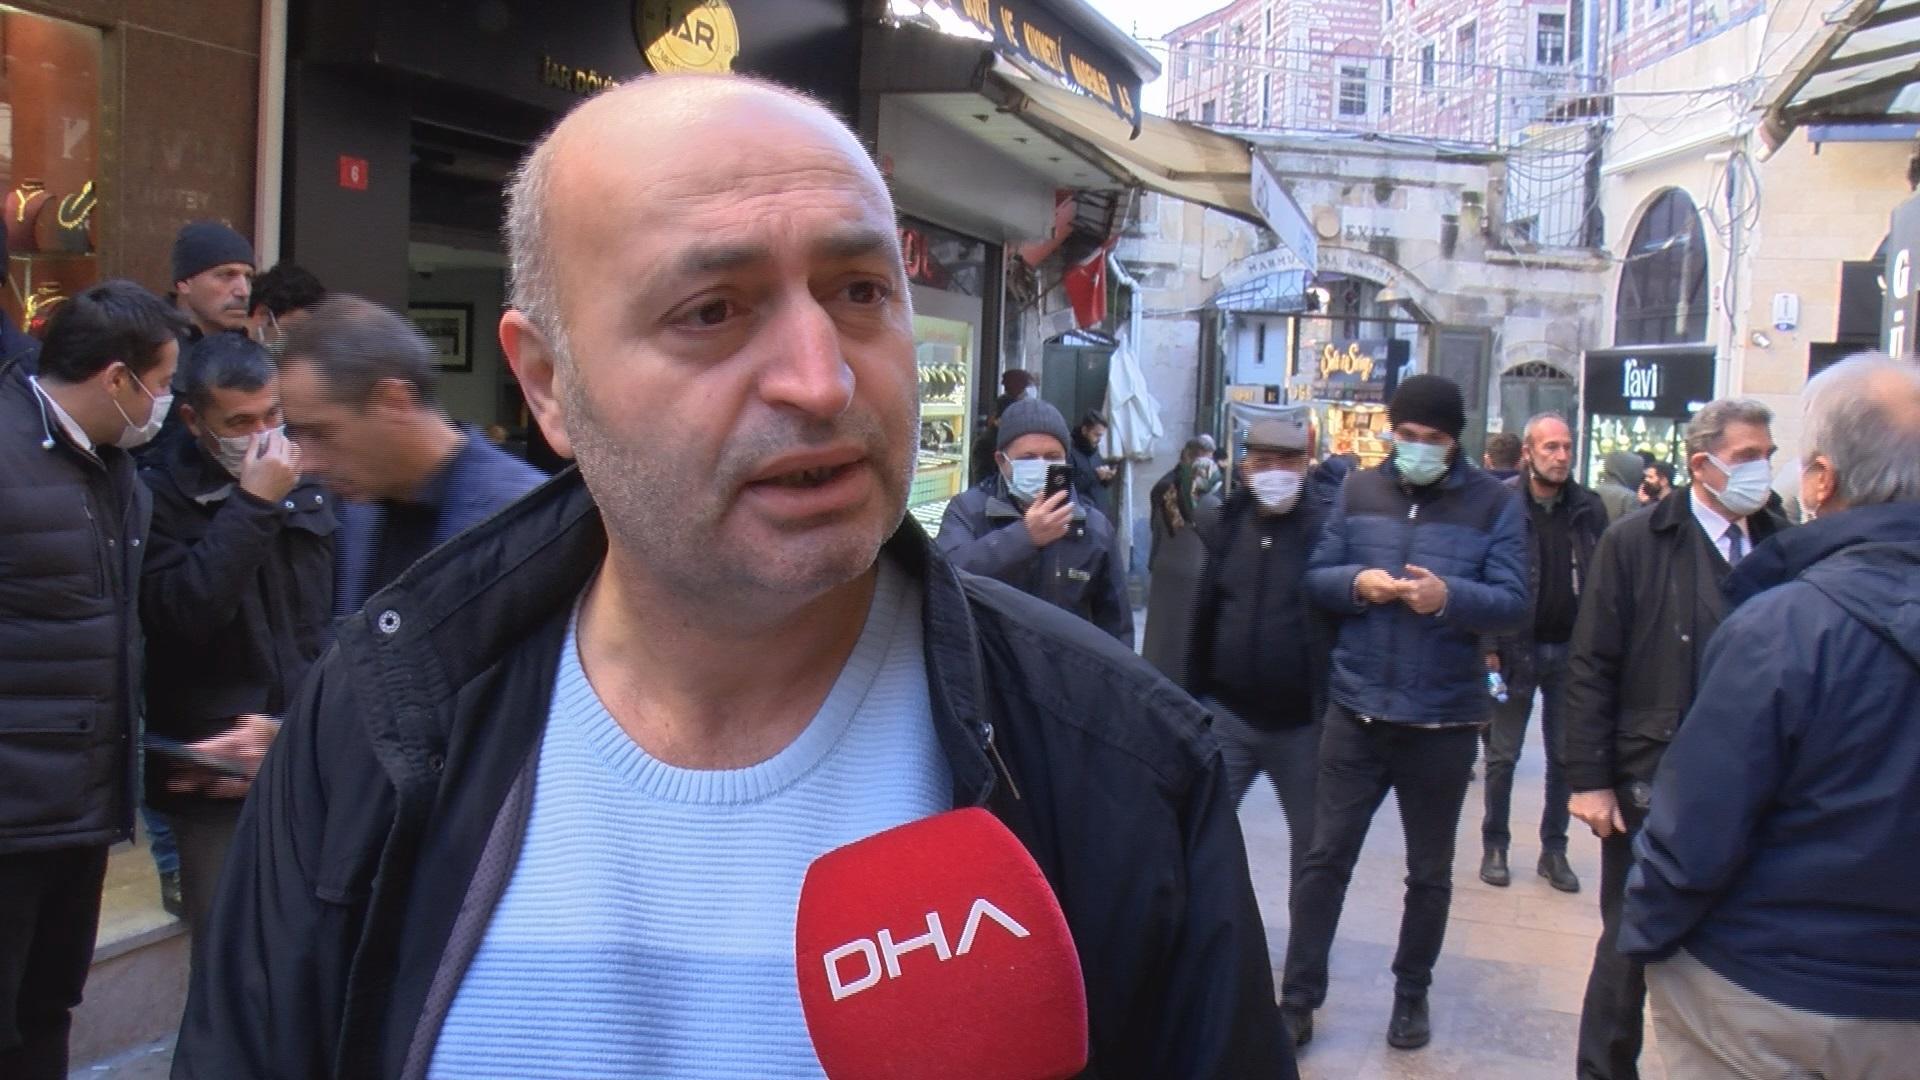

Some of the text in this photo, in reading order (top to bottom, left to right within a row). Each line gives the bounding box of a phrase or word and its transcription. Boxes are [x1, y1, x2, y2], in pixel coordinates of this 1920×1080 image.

[1000, 6, 1020, 48] VE
[351, 165, 360, 182] 6
[1622, 358, 1658, 398] ravi
[823, 898, 1031, 1002] DHA
